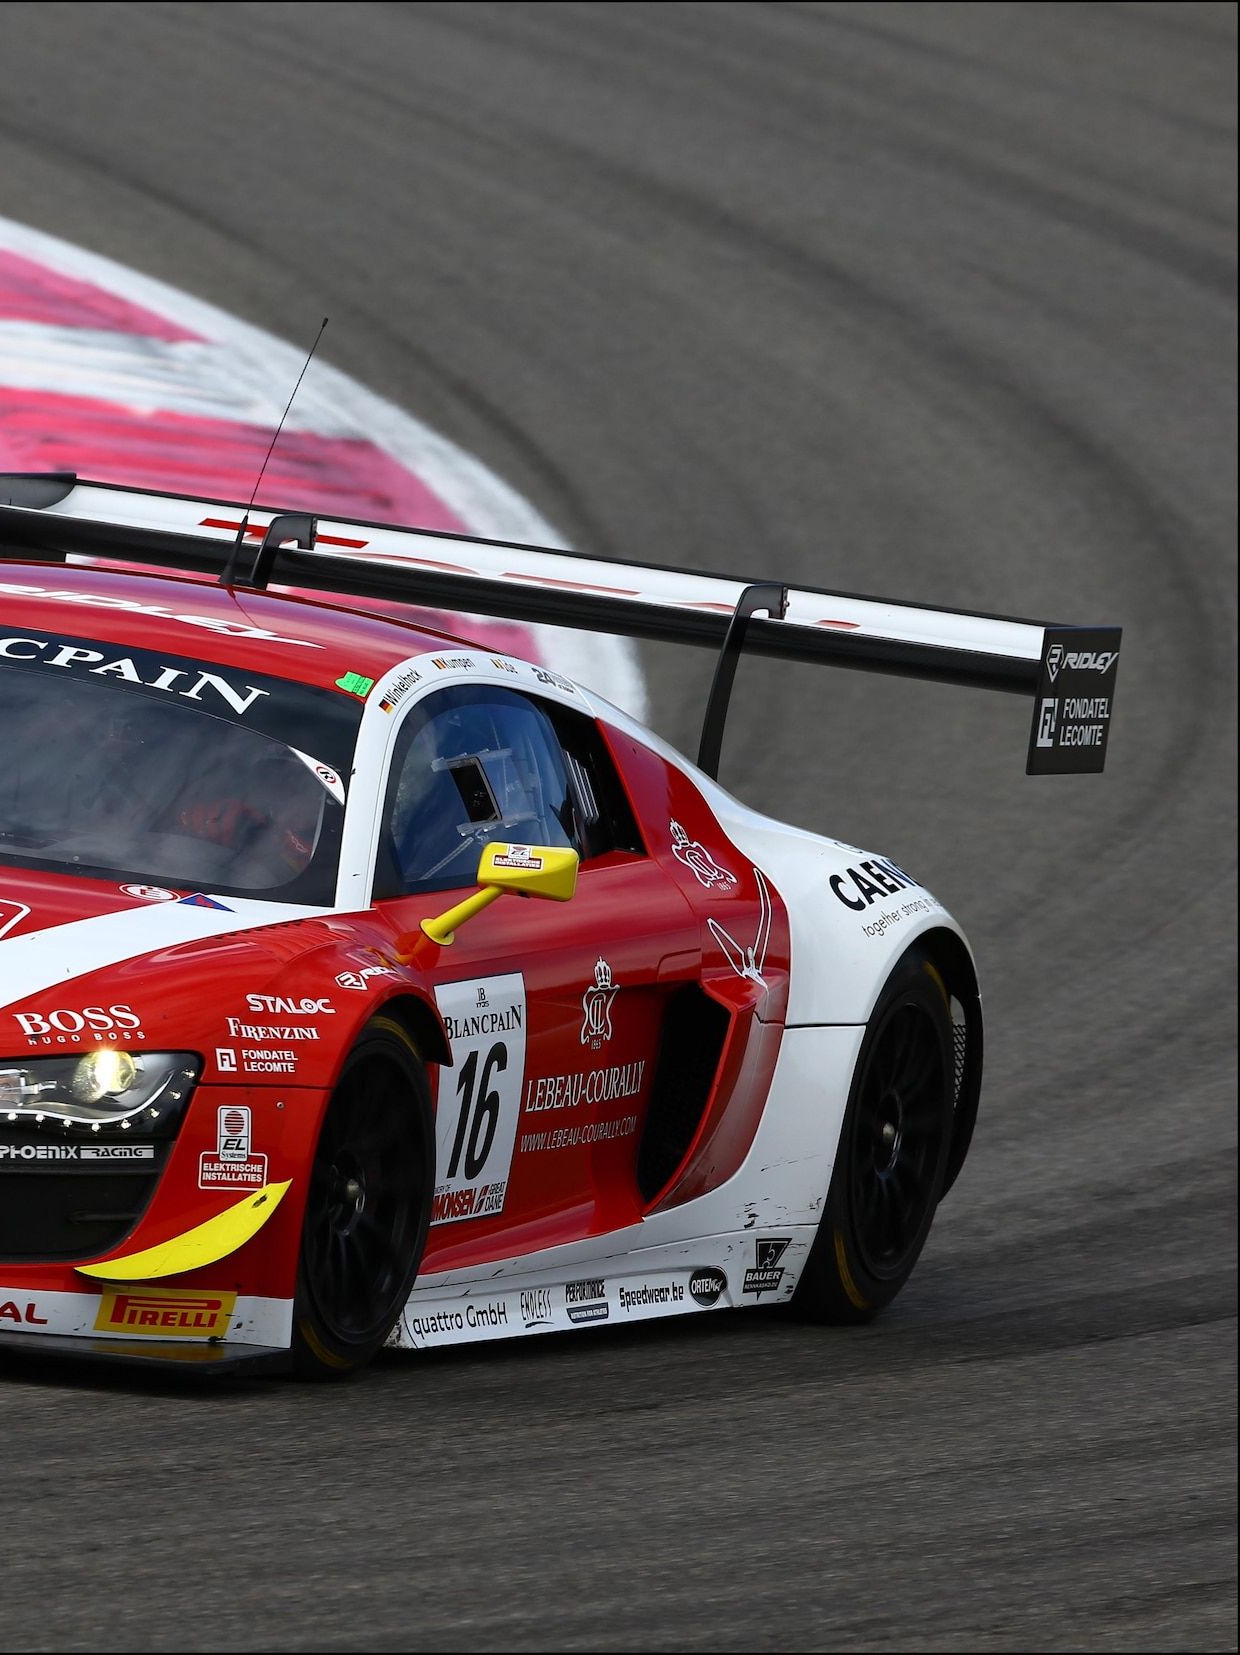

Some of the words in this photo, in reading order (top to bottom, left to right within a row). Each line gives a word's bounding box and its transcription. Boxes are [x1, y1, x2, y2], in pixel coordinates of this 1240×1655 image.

[1062, 652, 1119, 674] RIDLEY
[1063, 698, 1109, 719] FONDATEL
[1059, 724, 1104, 746] LECOMTE
[829, 859, 923, 911] CAEN
[862, 909, 903, 938] together
[246, 993, 336, 1014] STALOC
[12, 1005, 141, 1035] BOSS
[225, 1017, 320, 1041] FIRENZINI
[443, 1004, 522, 1040] BLANCPAIN
[28, 1033, 81, 1046] HUGO
[94, 1031, 146, 1041] BOSS
[242, 1049, 298, 1061] FONDATEL
[244, 1061, 295, 1073] LECOMTE
[525, 1060, 645, 1112] LEBEAU-COURALLY
[446, 1041, 508, 1181] 16
[223, 1138, 246, 1150] EL
[520, 1115, 637, 1153] WWW.LEBEAU-COURALLY.COM
[221, 1150, 247, 1160] Systems
[202, 1172, 262, 1182] INSTALLATIES
[203, 1162, 263, 1173] ELEKTRISCHE
[746, 1271, 782, 1281] BAUER
[520, 1289, 553, 1321] ENDLESS
[619, 1281, 684, 1312] Speedwear.be
[110, 1294, 223, 1328] PIRELLI
[413, 1311, 464, 1340] quattro
[466, 1302, 508, 1328] GmbH
